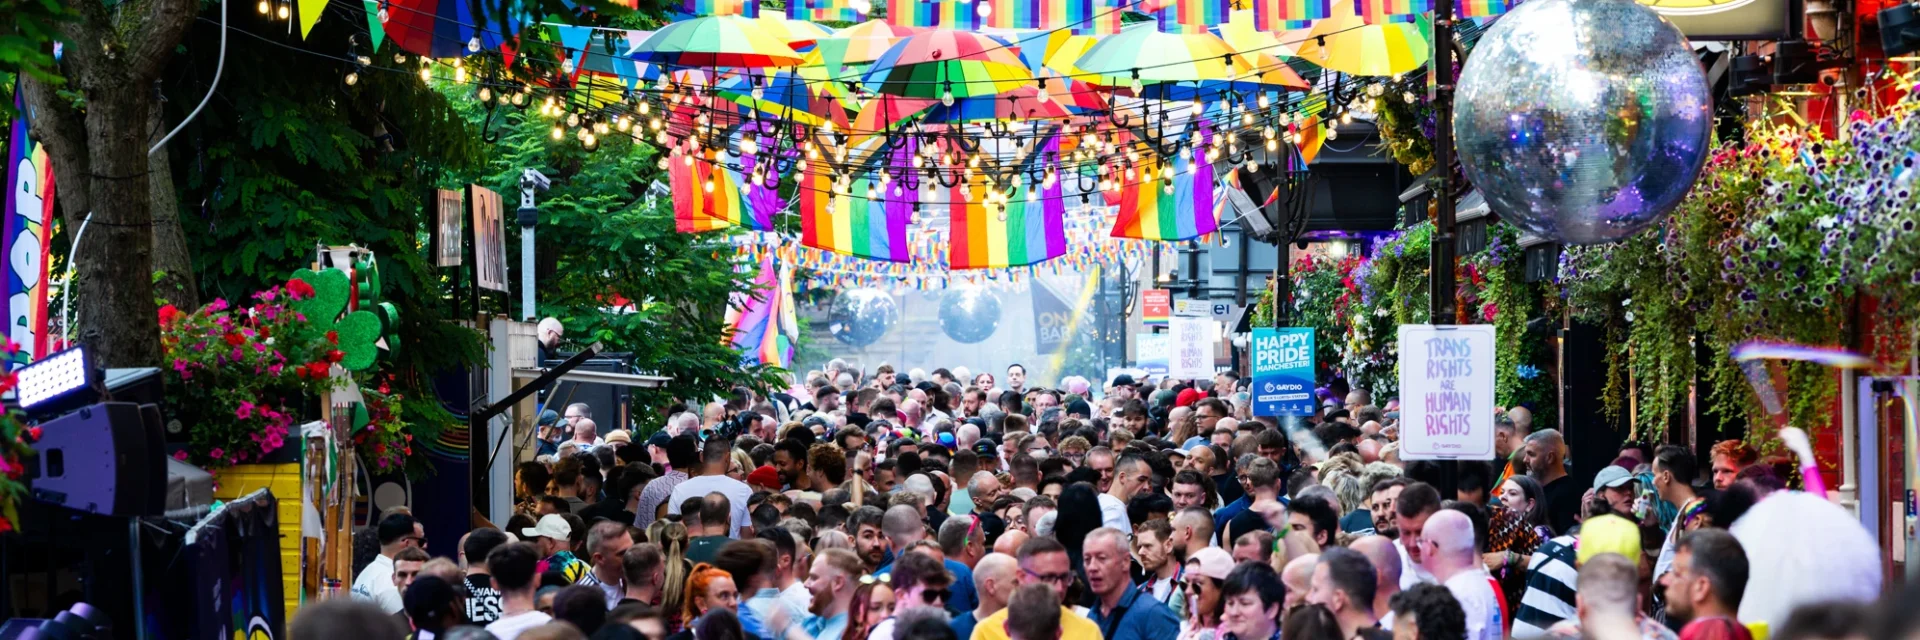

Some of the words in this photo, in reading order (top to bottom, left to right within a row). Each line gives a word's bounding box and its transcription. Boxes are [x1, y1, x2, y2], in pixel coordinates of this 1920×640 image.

[9, 157, 43, 368] POP
[1038, 311, 1068, 328] ON
[1256, 332, 1310, 350] HAPPY
[1424, 337, 1471, 358] TRANS
[1256, 345, 1310, 366] PRIDE
[1256, 360, 1310, 373] MANCHESTER!
[1426, 359, 1472, 380] RIGHTS
[1440, 380, 1455, 390] ARE
[1425, 392, 1471, 413] HUMAN
[1425, 414, 1471, 436] RIGHTS
